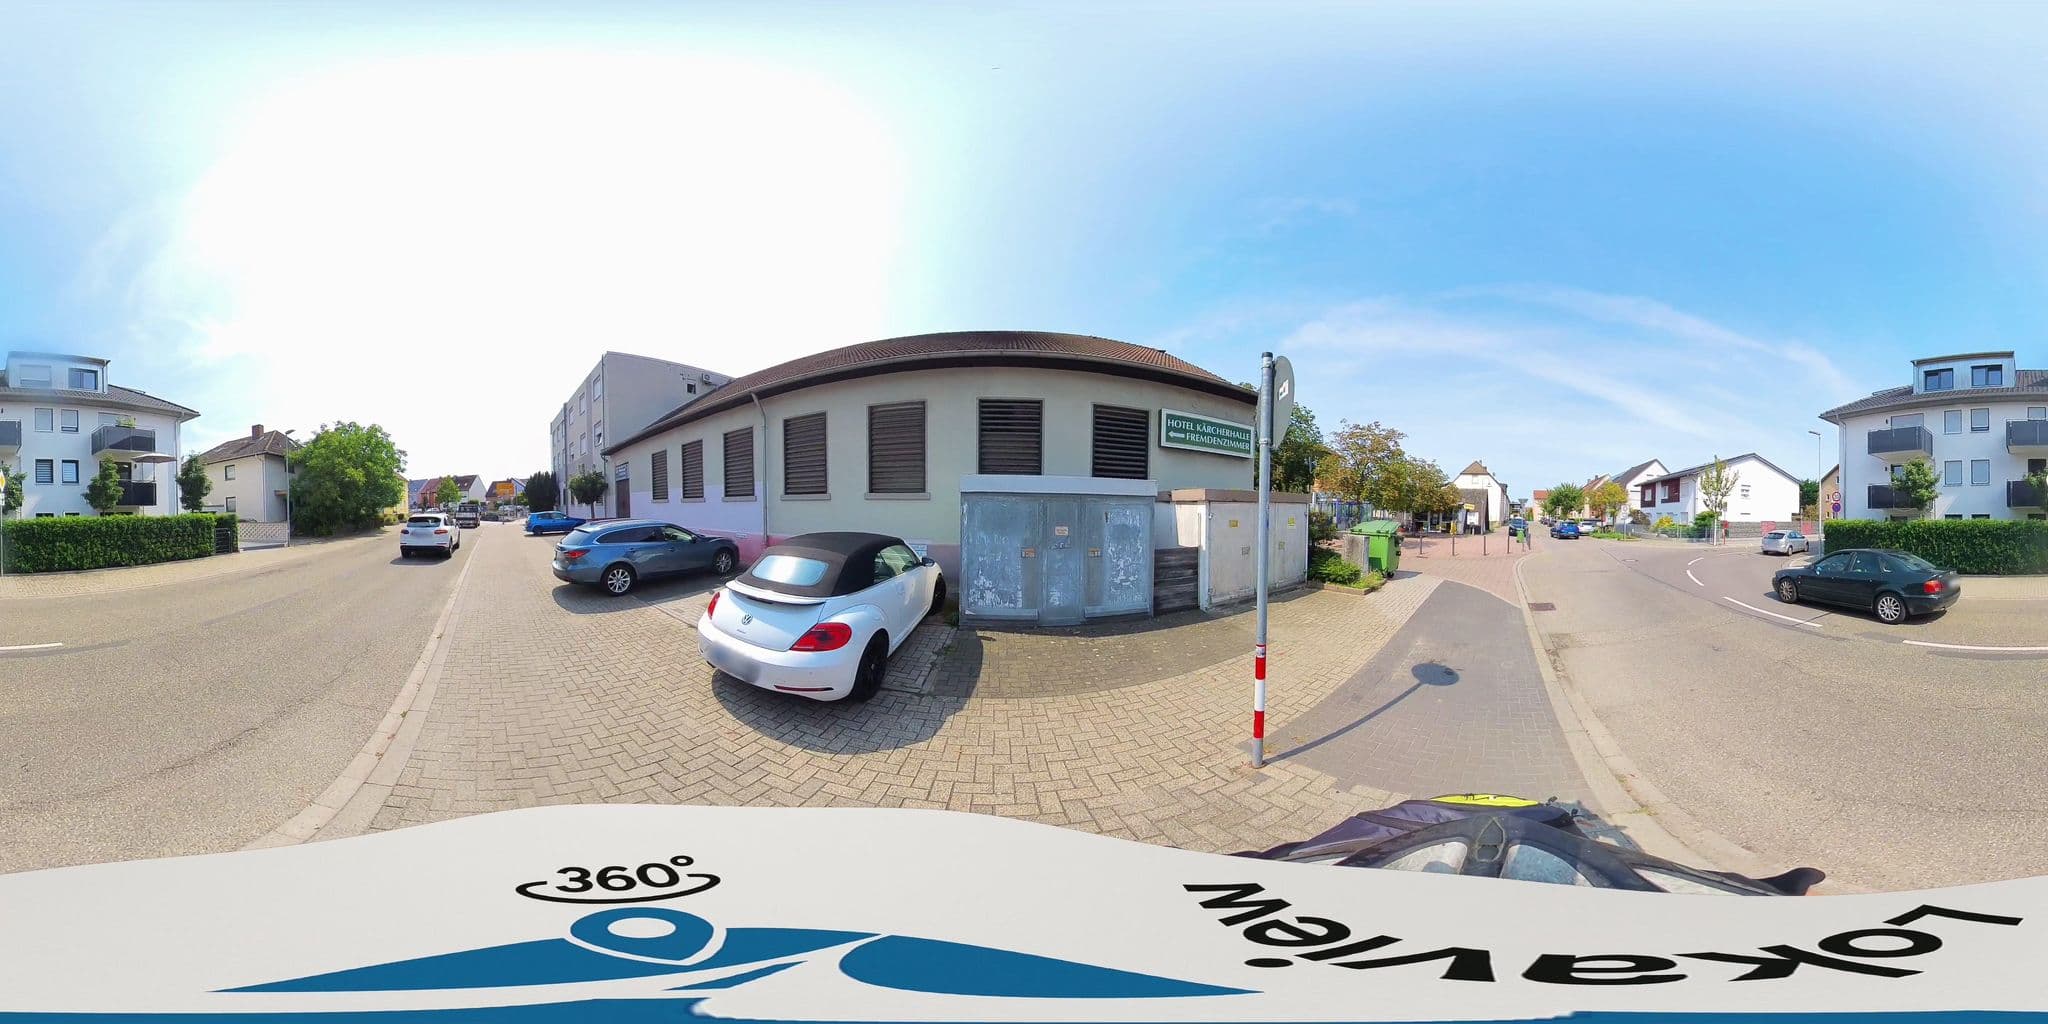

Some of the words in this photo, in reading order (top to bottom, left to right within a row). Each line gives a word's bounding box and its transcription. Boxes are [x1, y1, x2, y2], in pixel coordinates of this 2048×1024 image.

[1167, 419, 1194, 431] HOTEL
[1196, 422, 1250, 440] KÄRCHERHALLE
[1186, 432, 1250, 450] FREMDENZIMMER
